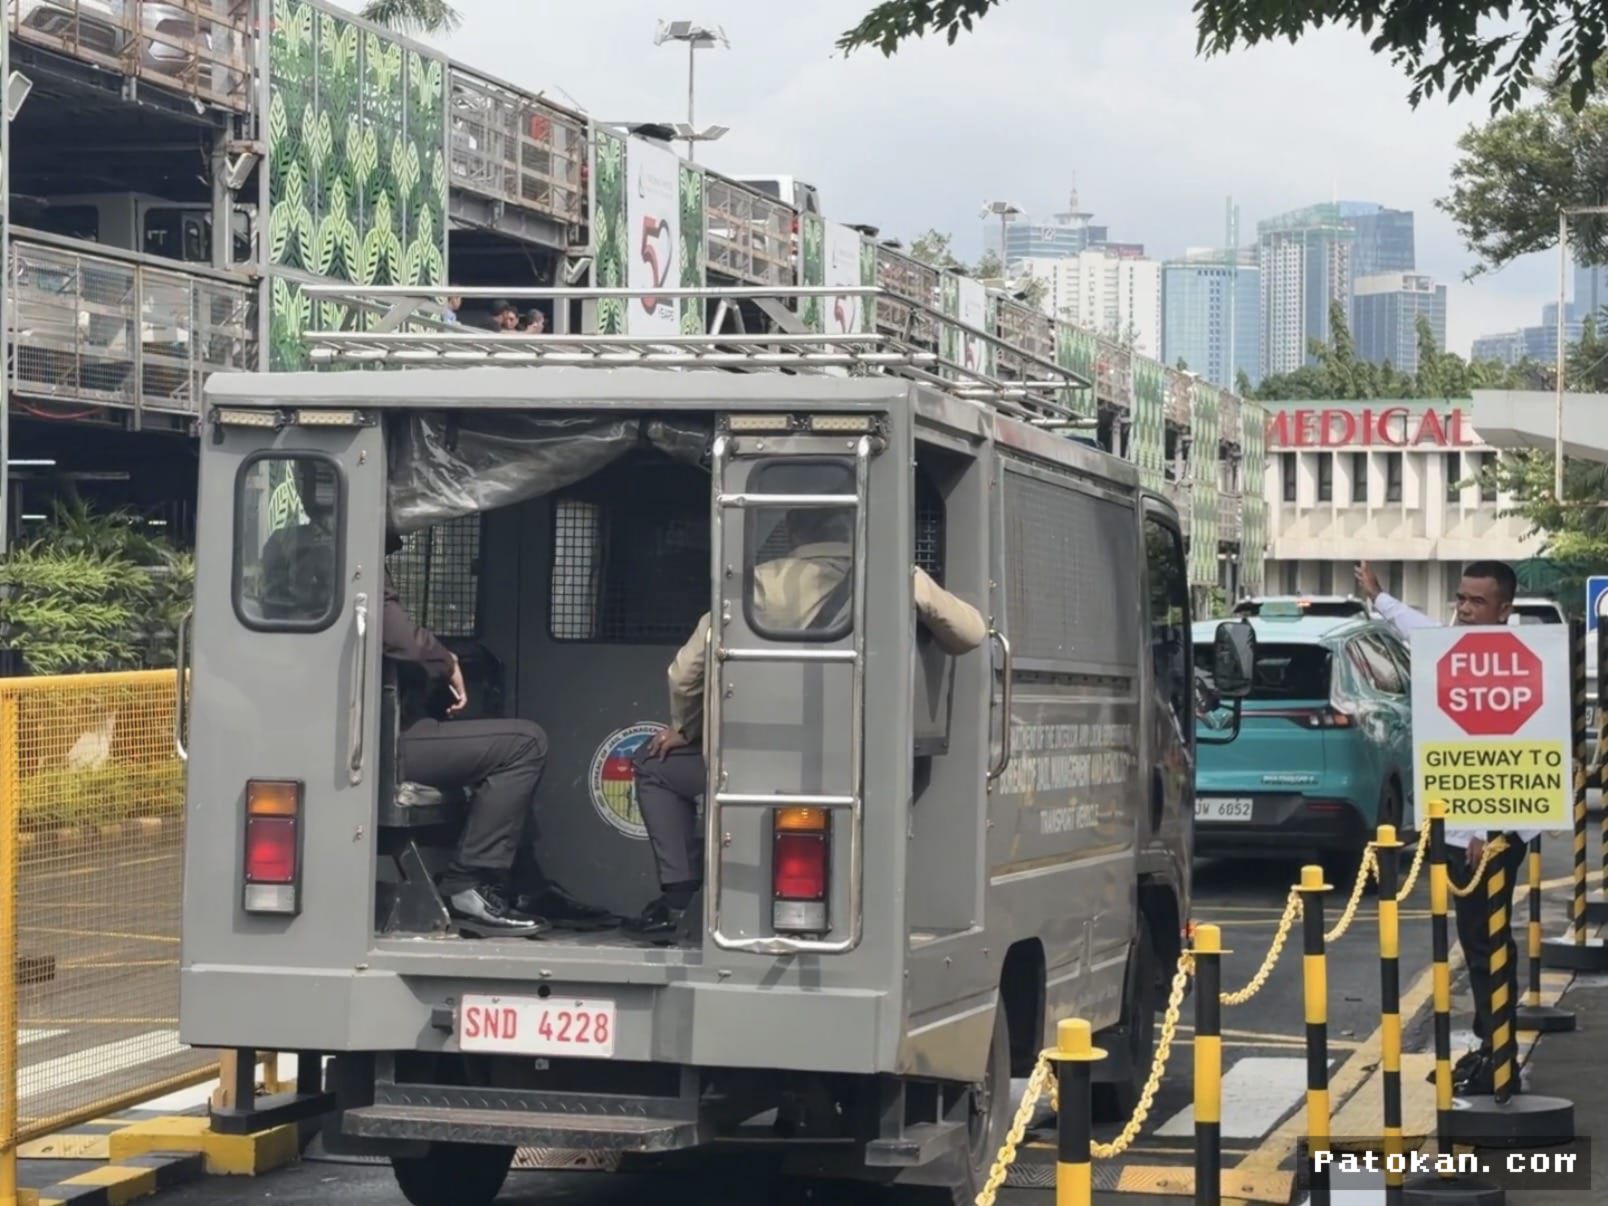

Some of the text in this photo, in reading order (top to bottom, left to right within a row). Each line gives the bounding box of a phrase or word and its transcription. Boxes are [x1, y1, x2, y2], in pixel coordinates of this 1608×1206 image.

[1265, 407, 1474, 448] MEDICAL
[1451, 652, 1530, 677] FULL
[1449, 685, 1532, 713] STOP
[1426, 750, 1562, 767] GIVEWAY TO
[1424, 773, 1561, 791] PEDESTRIAN
[1218, 803, 1250, 815] 6052
[465, 1007, 609, 1044] SND 4228
